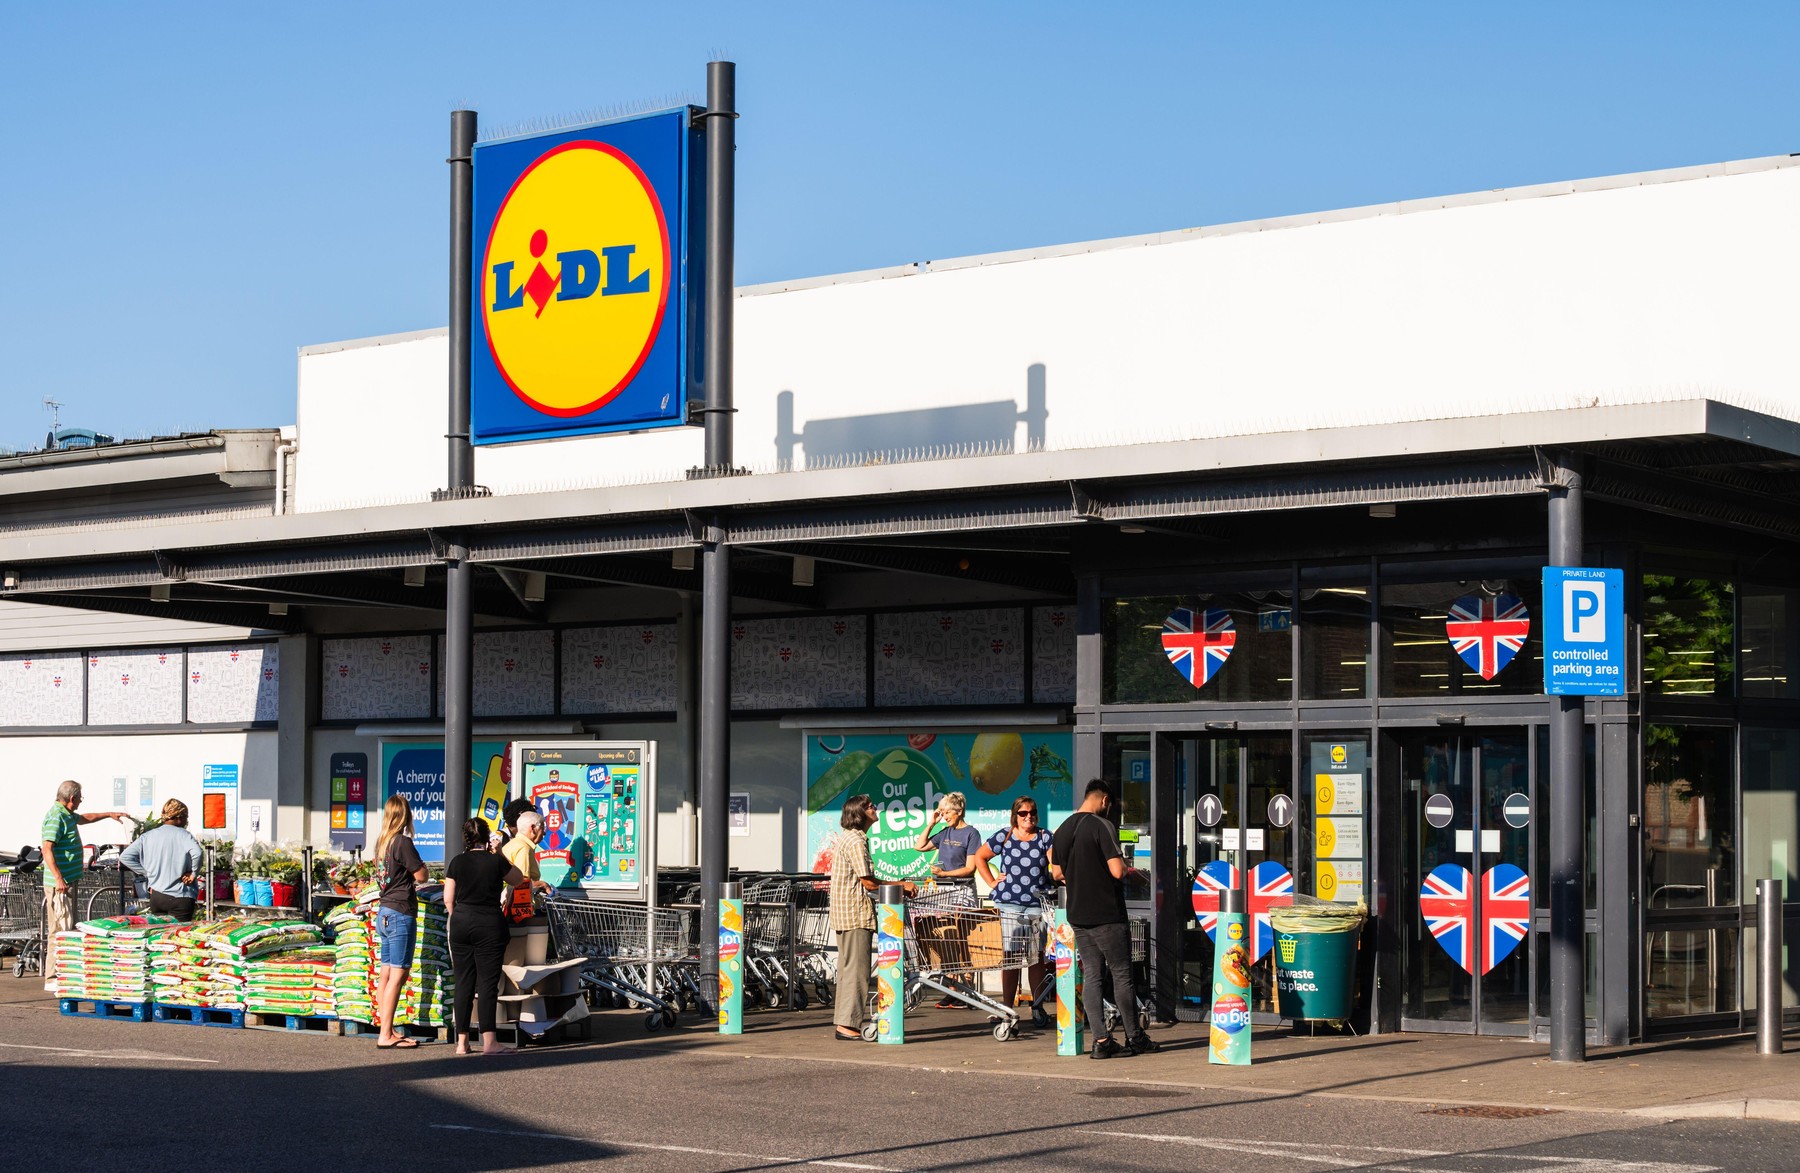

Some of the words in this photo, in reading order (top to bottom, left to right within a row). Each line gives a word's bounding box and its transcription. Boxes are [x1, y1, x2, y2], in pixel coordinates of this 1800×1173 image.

[1563, 570, 1587, 578] PRIVATE
[1572, 590, 1599, 633] P
[1553, 649, 1608, 660] controlled
[1553, 663, 1592, 677] parking
[1595, 665, 1619, 675] area
[598, 752, 615, 760] Upcoming
[206, 768, 210, 777] P
[590, 767, 604, 776] Middle
[1135, 765, 1141, 778] P
[396, 770, 404, 783] A
[406, 770, 437, 787] cherry
[594, 772, 605, 783] Lidl
[414, 788, 425, 801] of
[882, 782, 907, 798] Our
[486, 801, 497, 810] FREE
[867, 782, 946, 834] resh
[549, 816, 560, 828] £5
[877, 859, 898, 875] 100%
[900, 852, 926, 875] HAPPY
[874, 870, 883, 878] OR
[725, 934, 740, 944] on
[885, 940, 902, 951] on
[1057, 948, 1072, 958] on
[1285, 969, 1314, 979] waste
[1288, 980, 1318, 993] place.
[1213, 1013, 1228, 1024] on
[1229, 1009, 1250, 1026] Big
